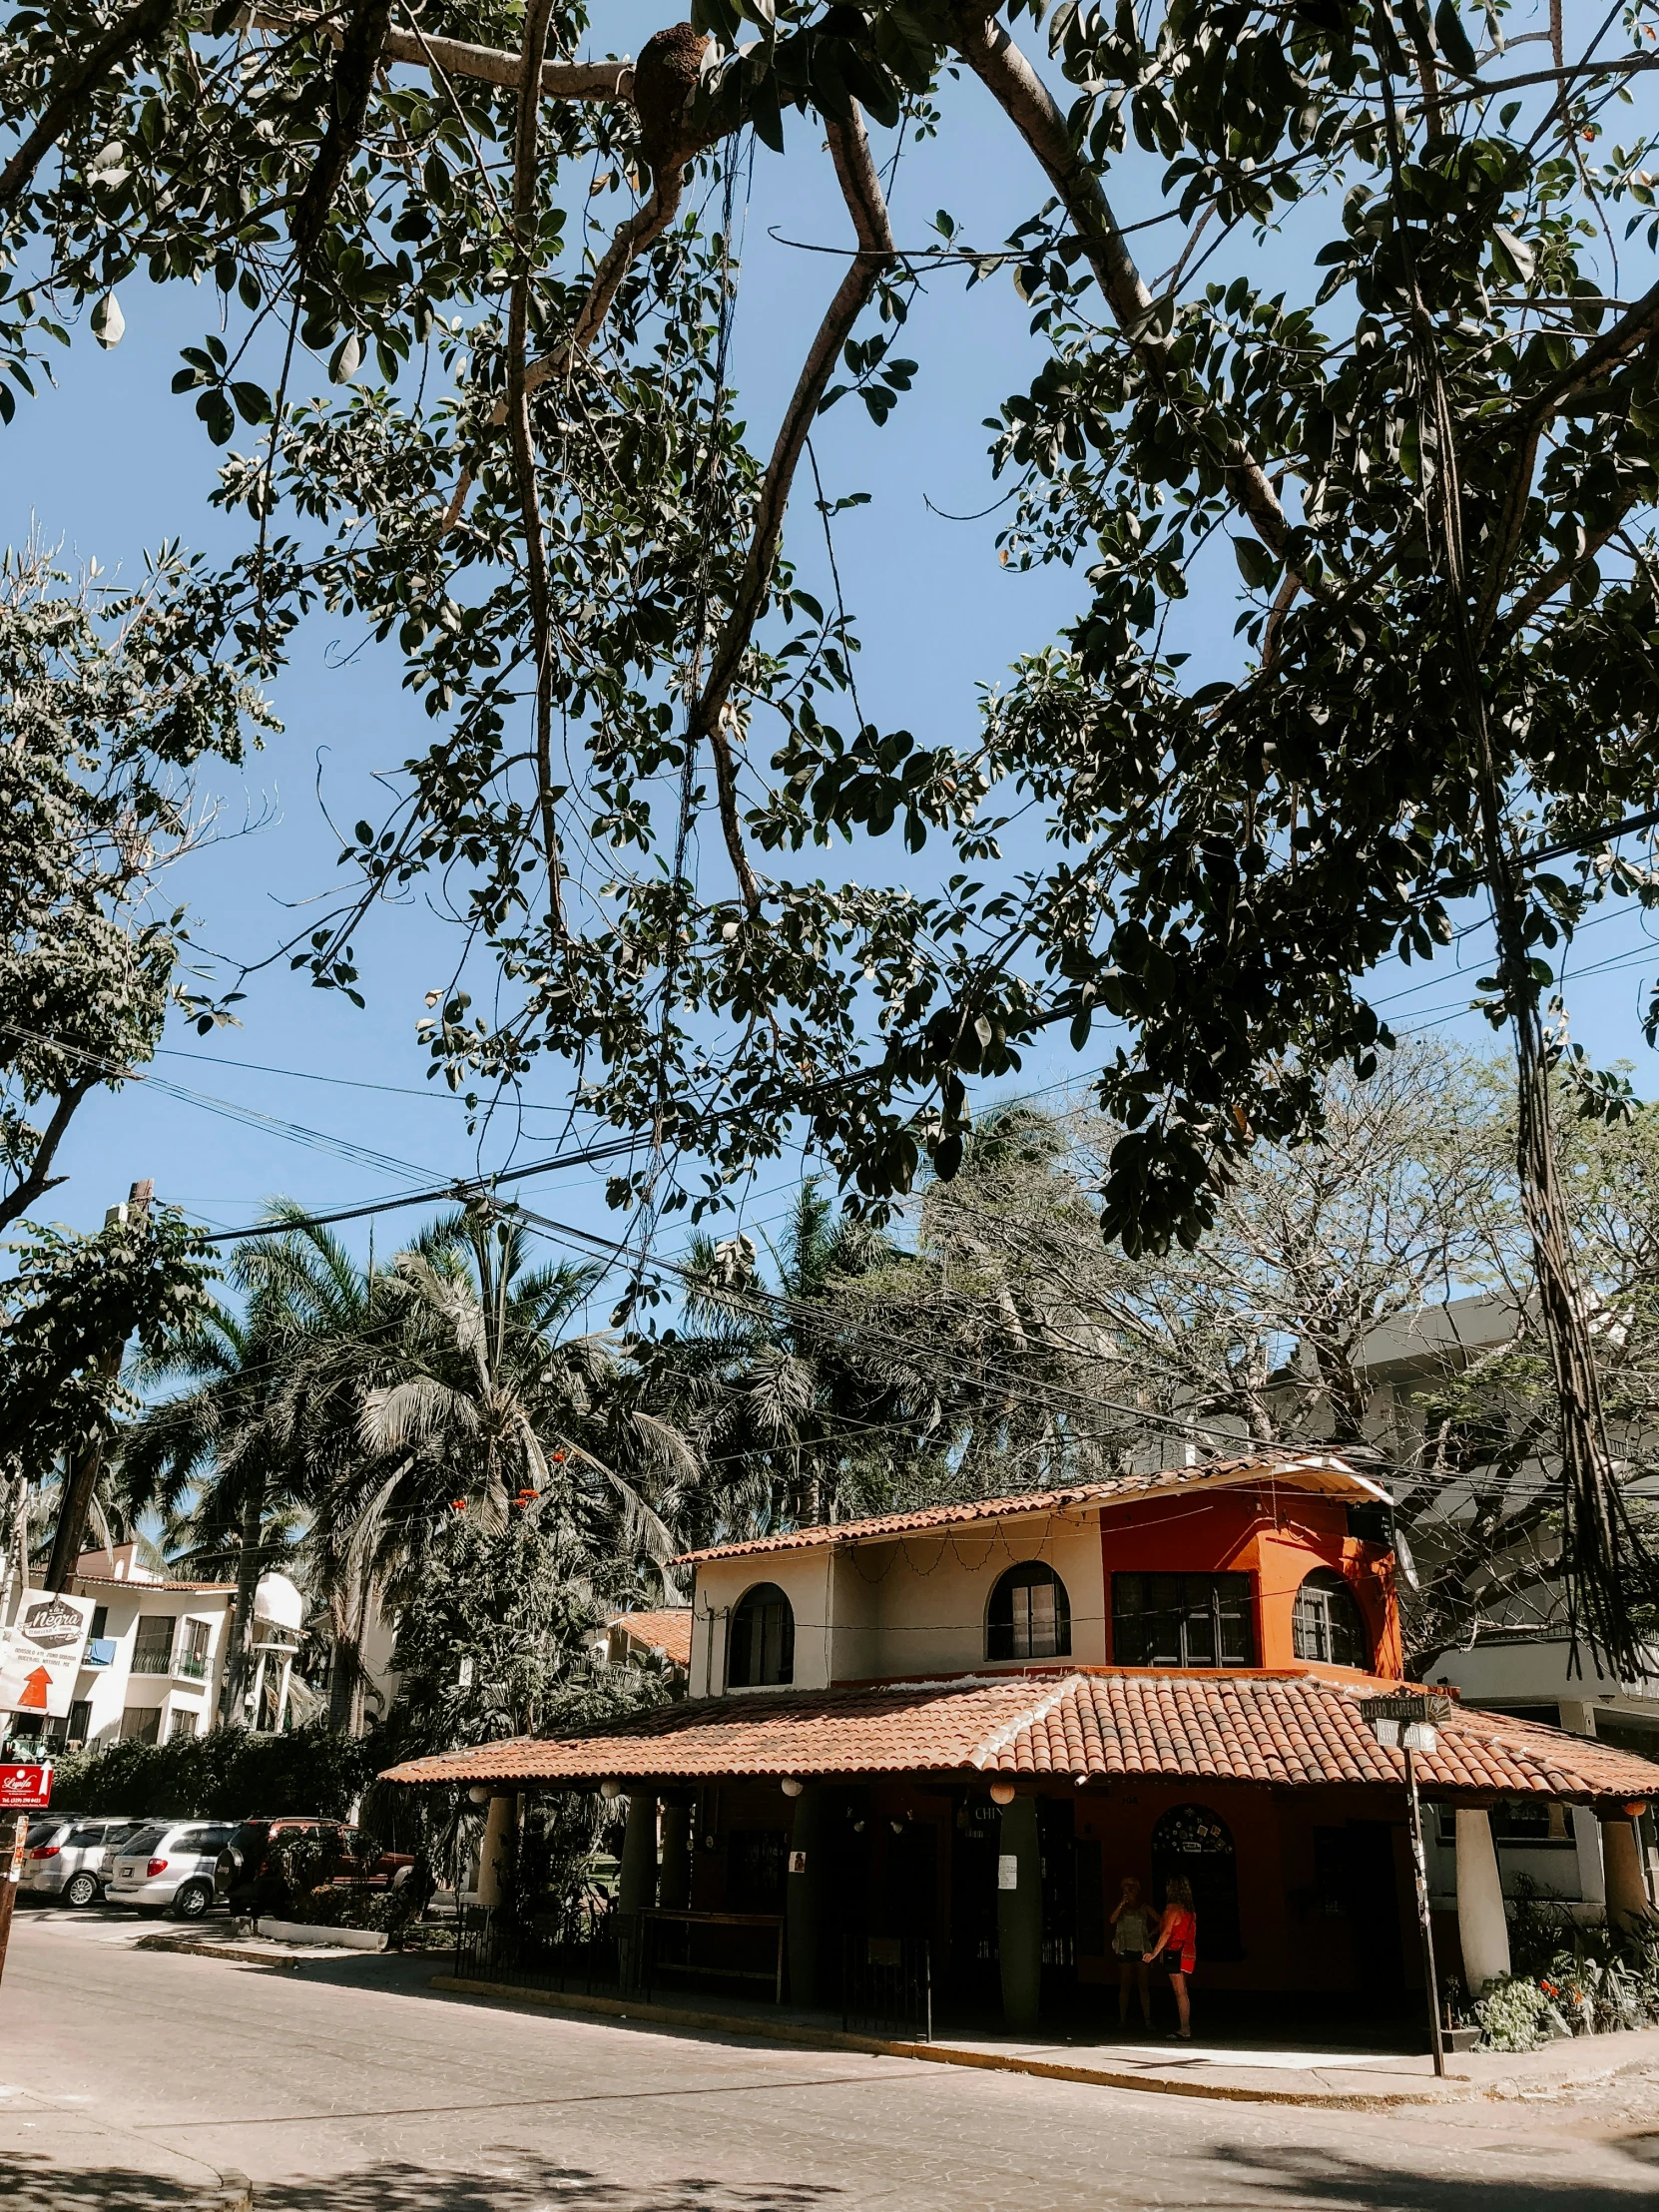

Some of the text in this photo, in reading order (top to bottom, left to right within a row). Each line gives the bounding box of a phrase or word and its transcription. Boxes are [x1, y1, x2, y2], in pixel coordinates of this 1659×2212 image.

[33, 1611, 79, 1628] Negra
[1362, 1702, 1387, 1718] LAZARO
[1390, 1700, 1423, 1717] CARDENAS
[217, 1864, 230, 1875] Jeep
